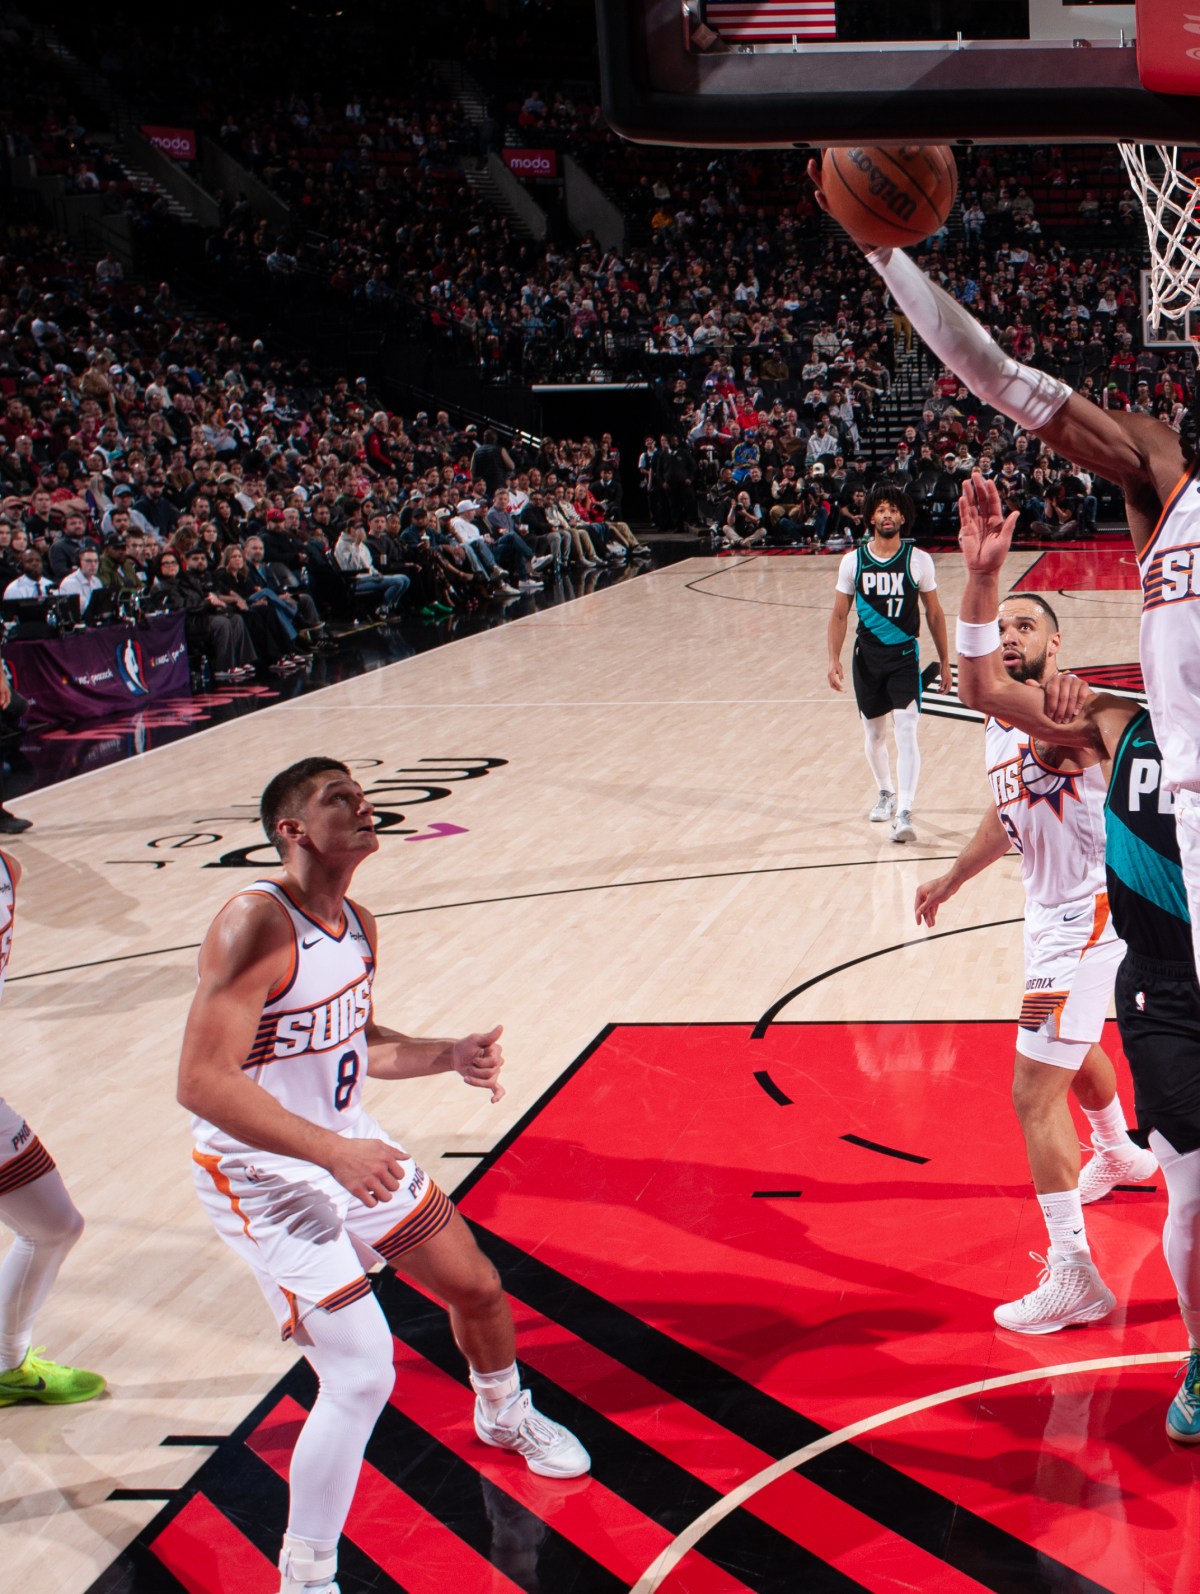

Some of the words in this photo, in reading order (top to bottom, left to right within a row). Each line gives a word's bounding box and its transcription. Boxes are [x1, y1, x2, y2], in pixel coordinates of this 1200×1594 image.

[510, 156, 550, 169] moda
[862, 572, 905, 596] PDX
[886, 597, 904, 618] 17
[334, 1049, 360, 1112] 8
